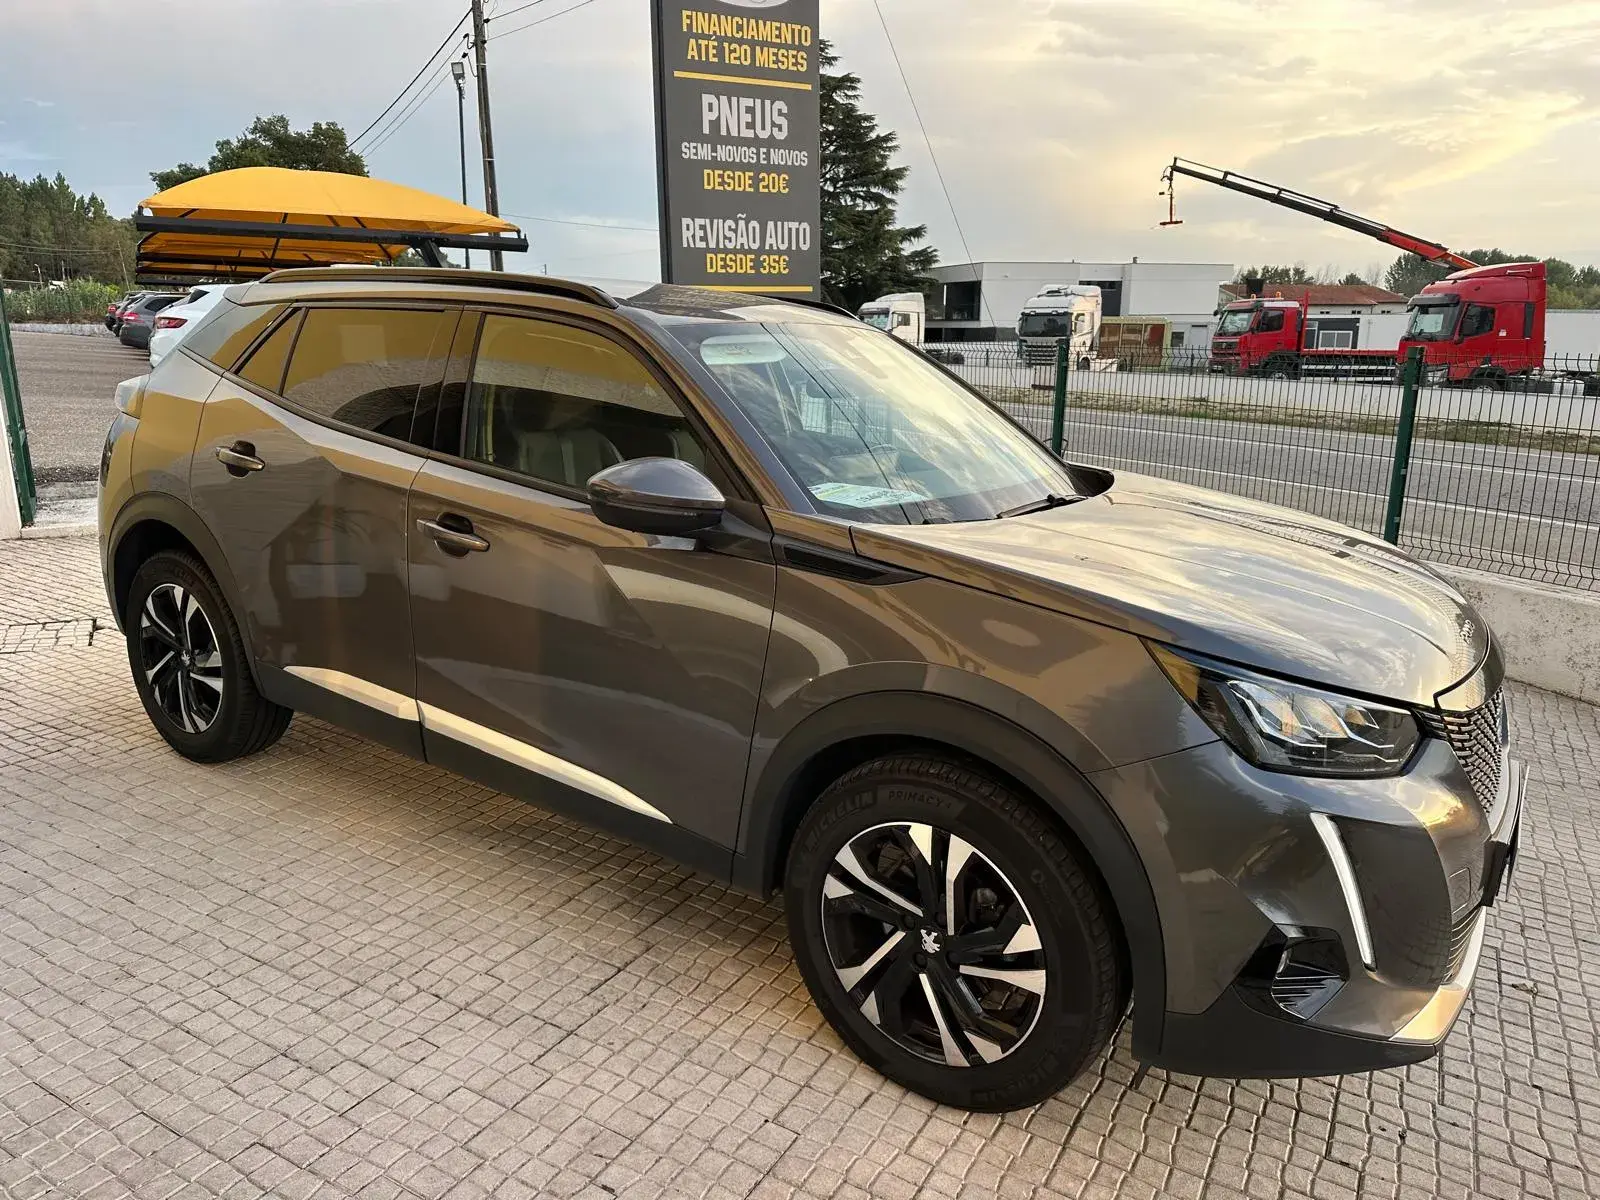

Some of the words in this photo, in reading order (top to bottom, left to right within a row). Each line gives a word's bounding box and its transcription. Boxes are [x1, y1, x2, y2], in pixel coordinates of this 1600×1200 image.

[682, 10, 811, 46] FINANCIAMENTO
[687, 36, 718, 62] ATÉ
[723, 42, 751, 66] 120
[755, 46, 807, 72] MESES
[701, 93, 788, 140] PNEUS
[681, 142, 757, 163] SEMI-NOVOS
[760, 148, 767, 164] E
[770, 148, 808, 166] NOVOS
[703, 169, 754, 192] DESDE
[759, 173, 789, 194] 20€
[682, 213, 760, 250] REVISÃO
[765, 220, 810, 251] AUTO
[706, 253, 755, 273] DESDE
[760, 254, 789, 274] 35€
[889, 790, 944, 808] PRIMACY
[804, 789, 874, 853] MICHELIN
